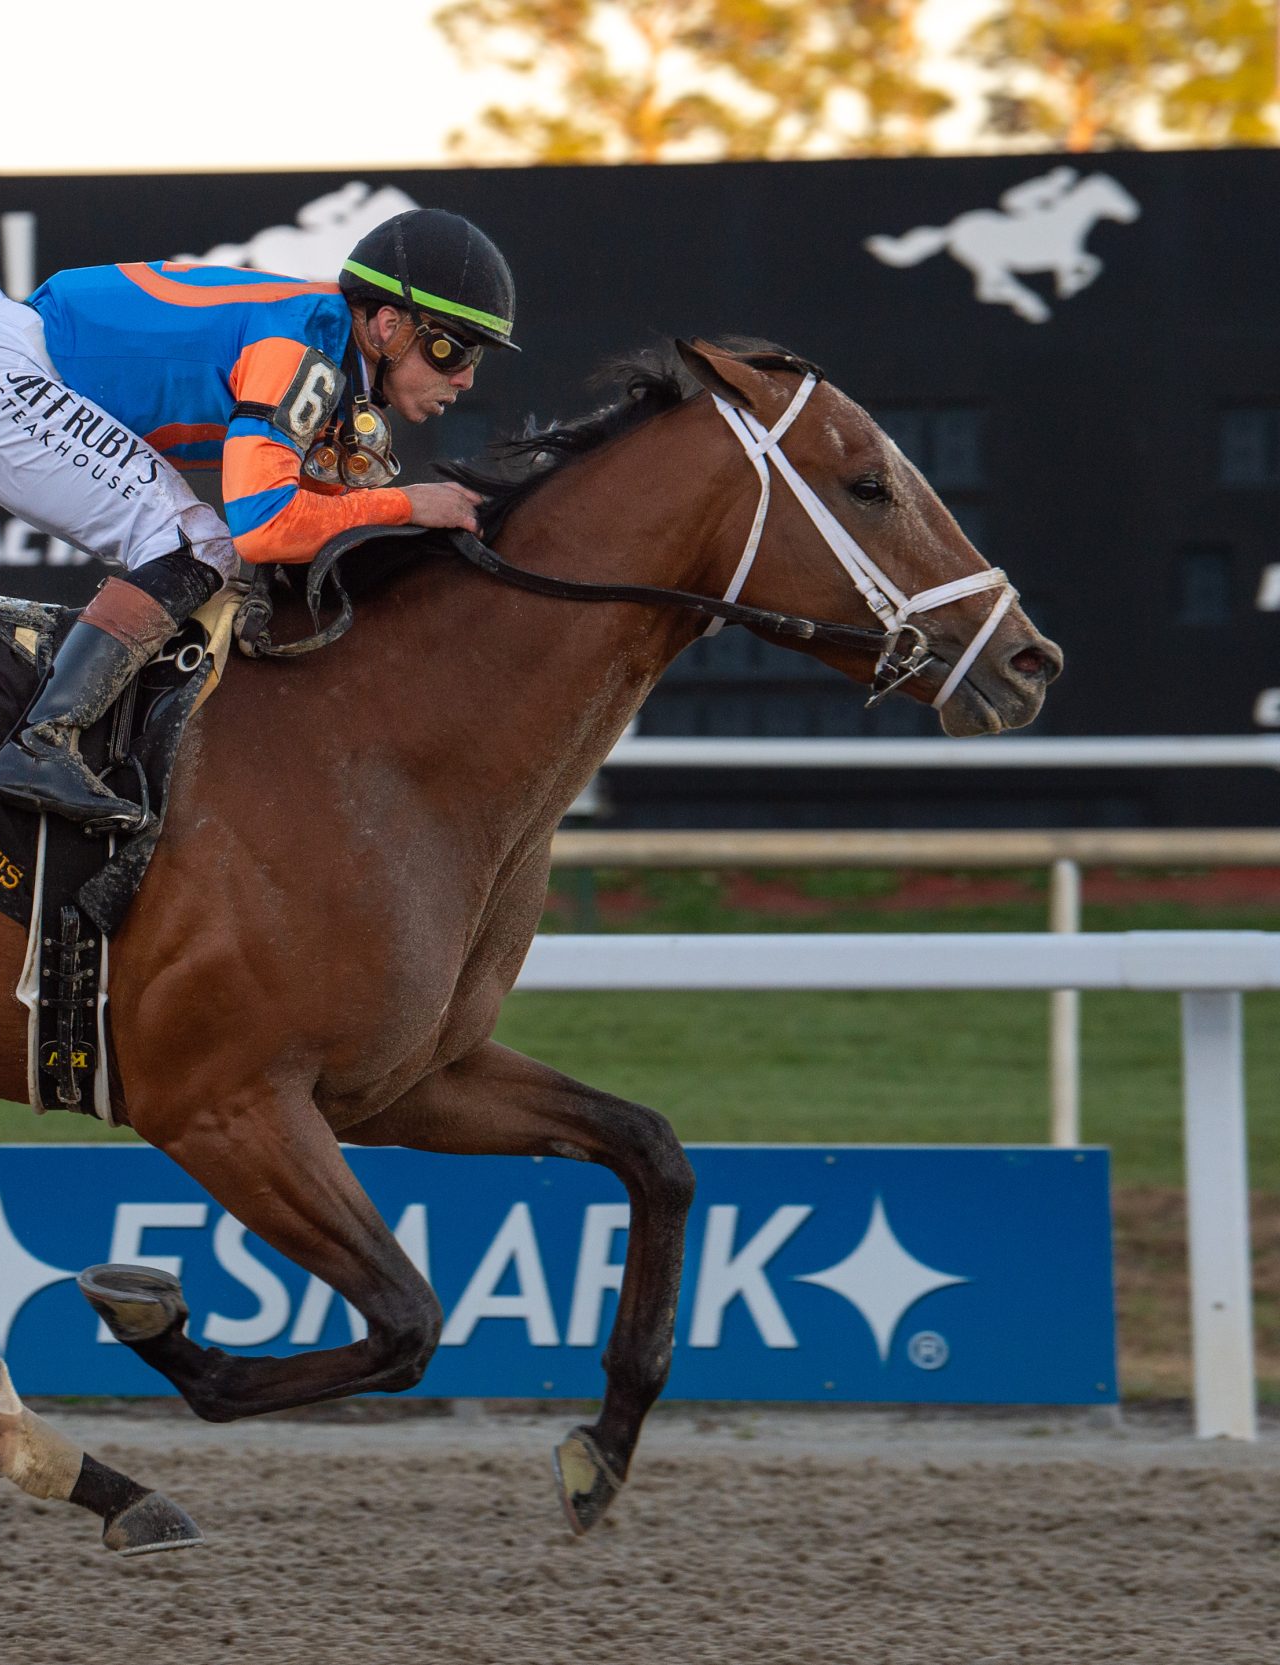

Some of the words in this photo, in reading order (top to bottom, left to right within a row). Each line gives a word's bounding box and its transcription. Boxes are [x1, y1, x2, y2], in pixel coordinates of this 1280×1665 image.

[6, 372, 77, 421] JEFF
[61, 403, 166, 485] RUBY'S
[289, 363, 335, 437] 6
